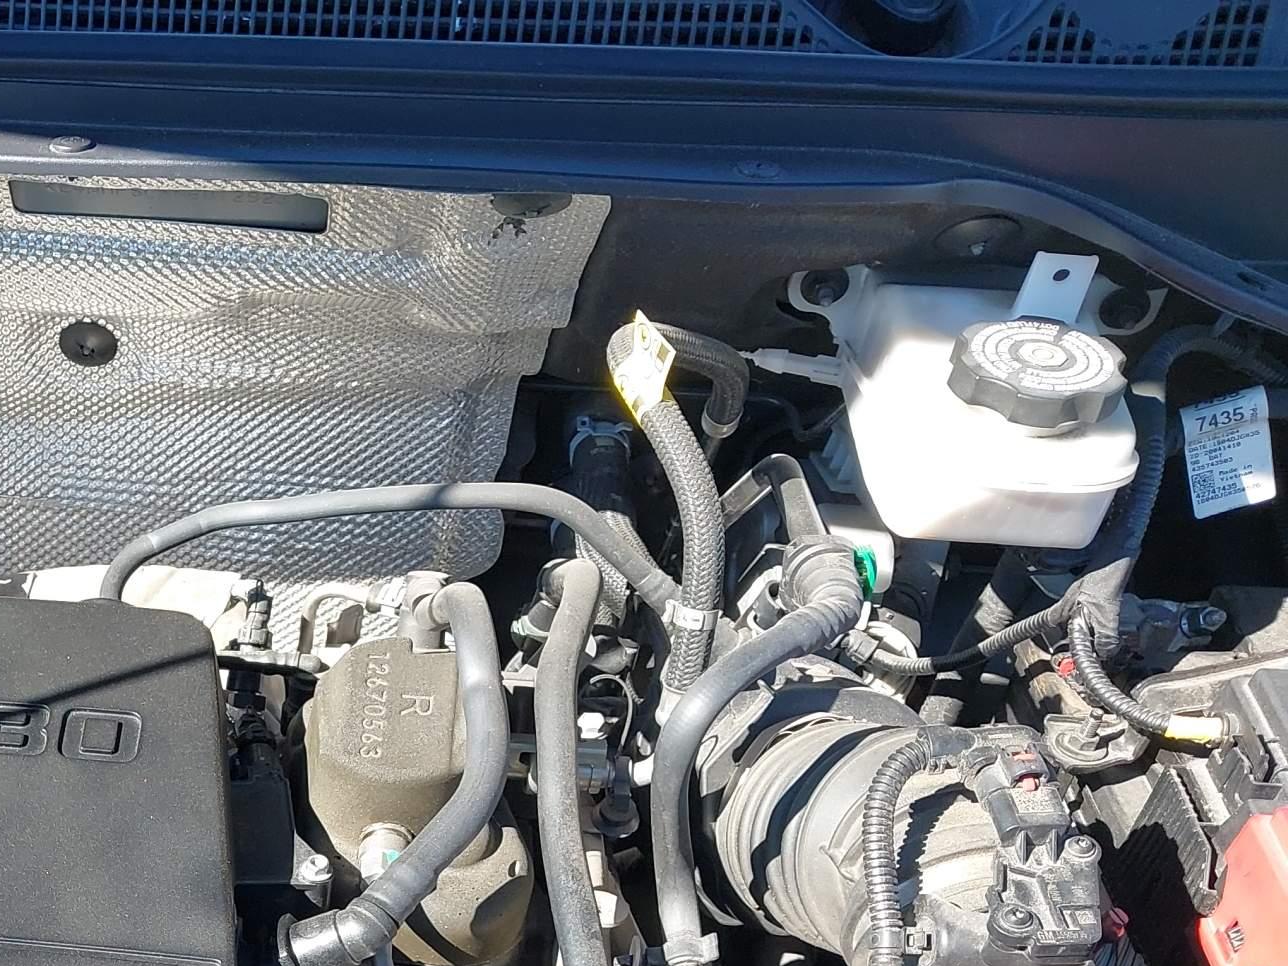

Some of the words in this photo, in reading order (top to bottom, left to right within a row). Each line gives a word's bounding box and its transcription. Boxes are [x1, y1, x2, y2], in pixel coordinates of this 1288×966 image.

[1195, 406, 1245, 432] 7435
[359, 652, 391, 758] 12670563
[400, 693, 434, 716] R
